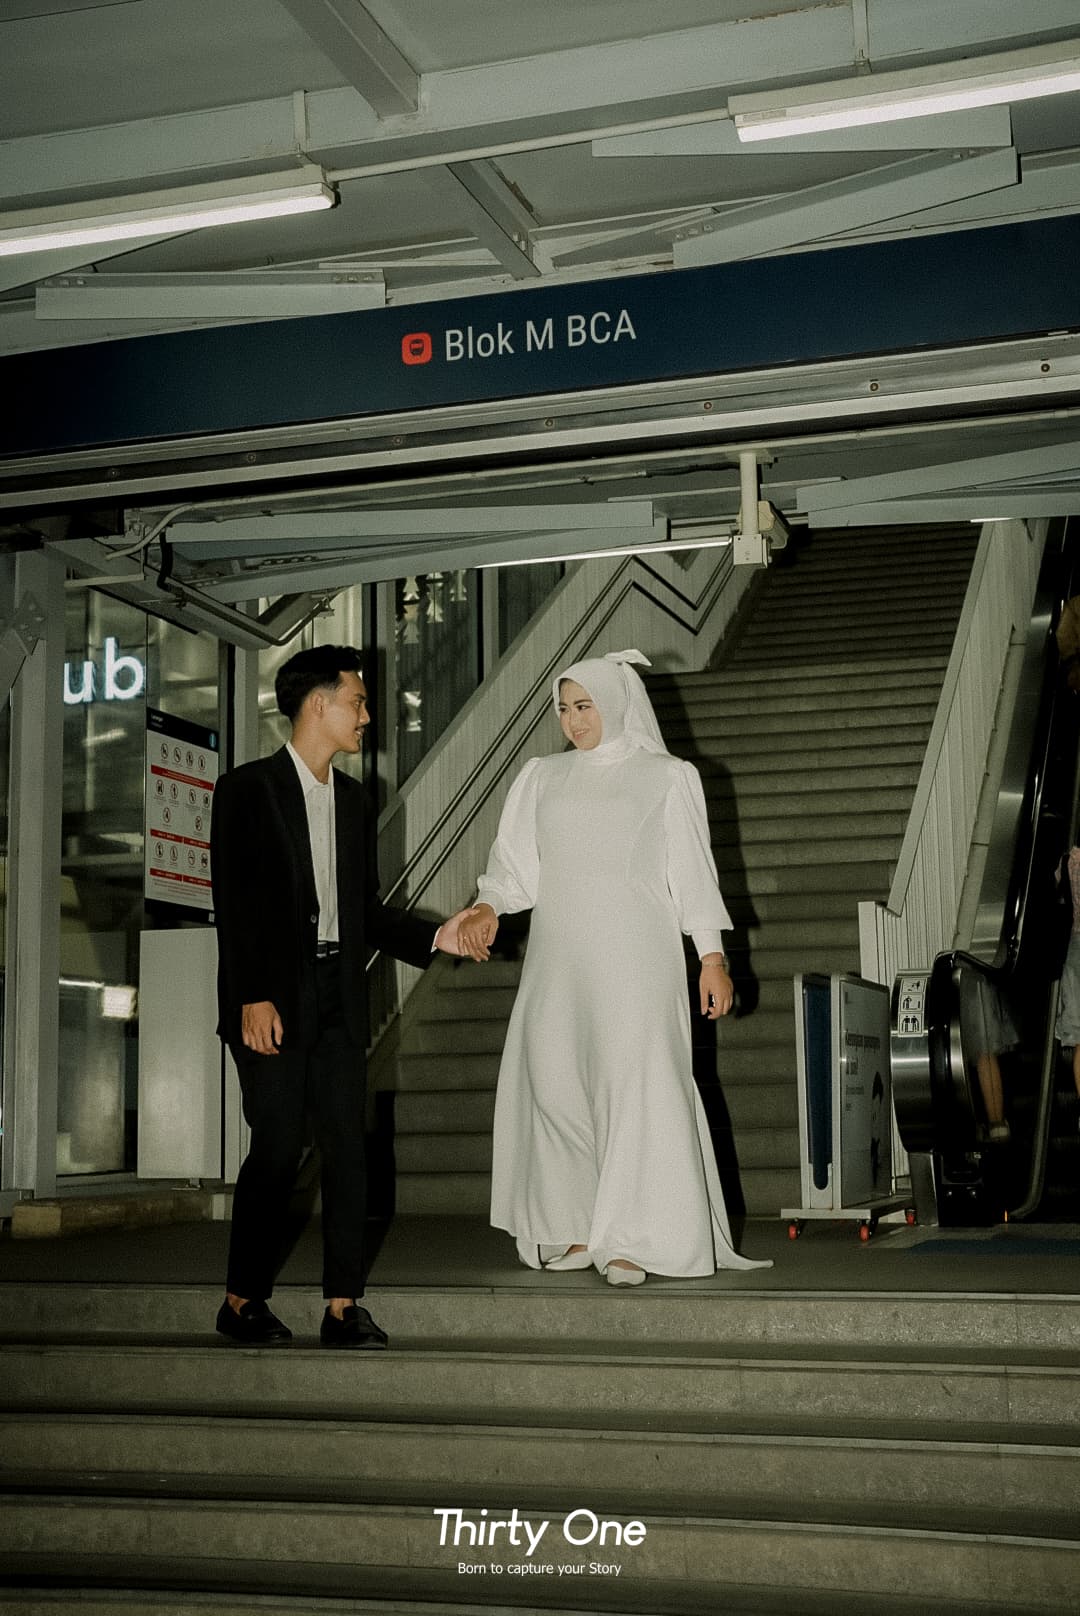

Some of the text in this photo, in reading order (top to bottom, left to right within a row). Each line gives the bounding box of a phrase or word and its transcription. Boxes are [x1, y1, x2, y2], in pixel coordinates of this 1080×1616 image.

[445, 309, 637, 361] Blok M BCA
